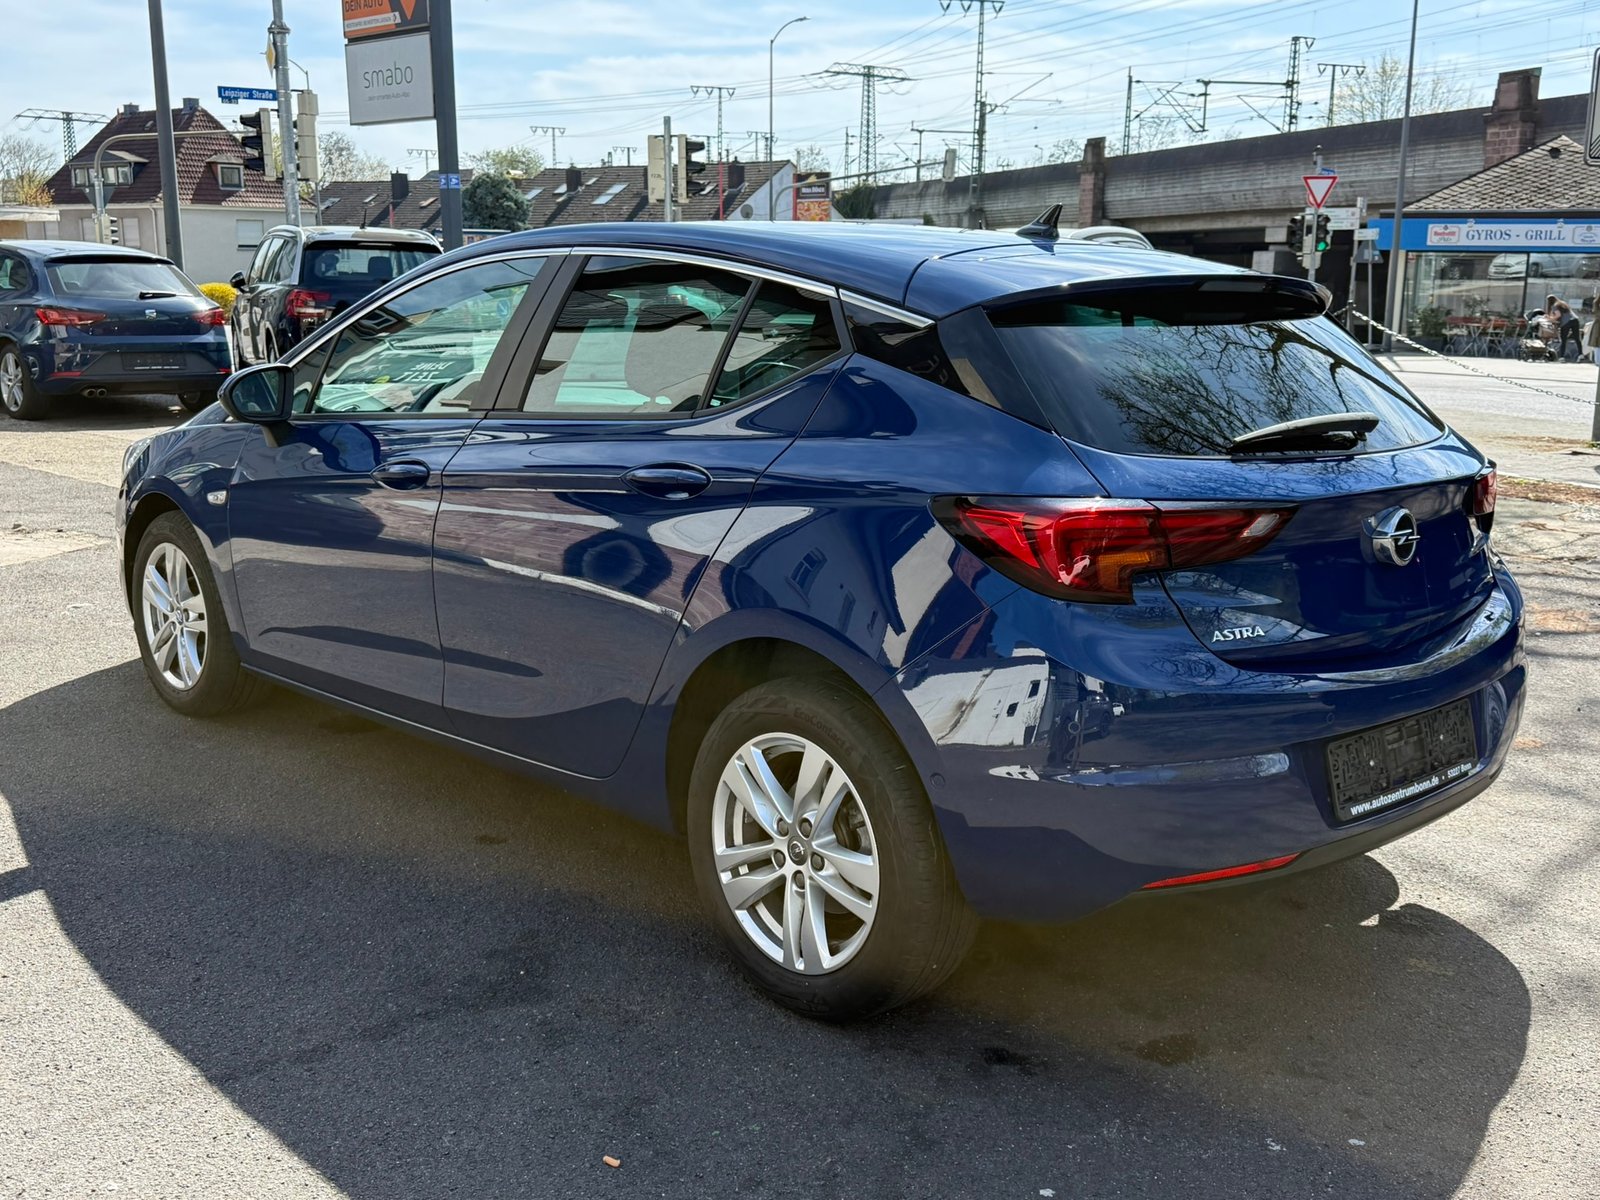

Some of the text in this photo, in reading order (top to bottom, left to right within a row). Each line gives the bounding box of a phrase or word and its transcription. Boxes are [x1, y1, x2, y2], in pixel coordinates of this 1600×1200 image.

[345, 0, 362, 12] DEIN
[363, 60, 413, 89] smabo
[221, 88, 273, 99] Leipziger Straße
[1465, 229, 1512, 241] GYROS
[1525, 229, 1565, 241] GRILL
[1211, 625, 1265, 643] ASTRA
[1350, 776, 1439, 815] www.autozentrumbonn.de
